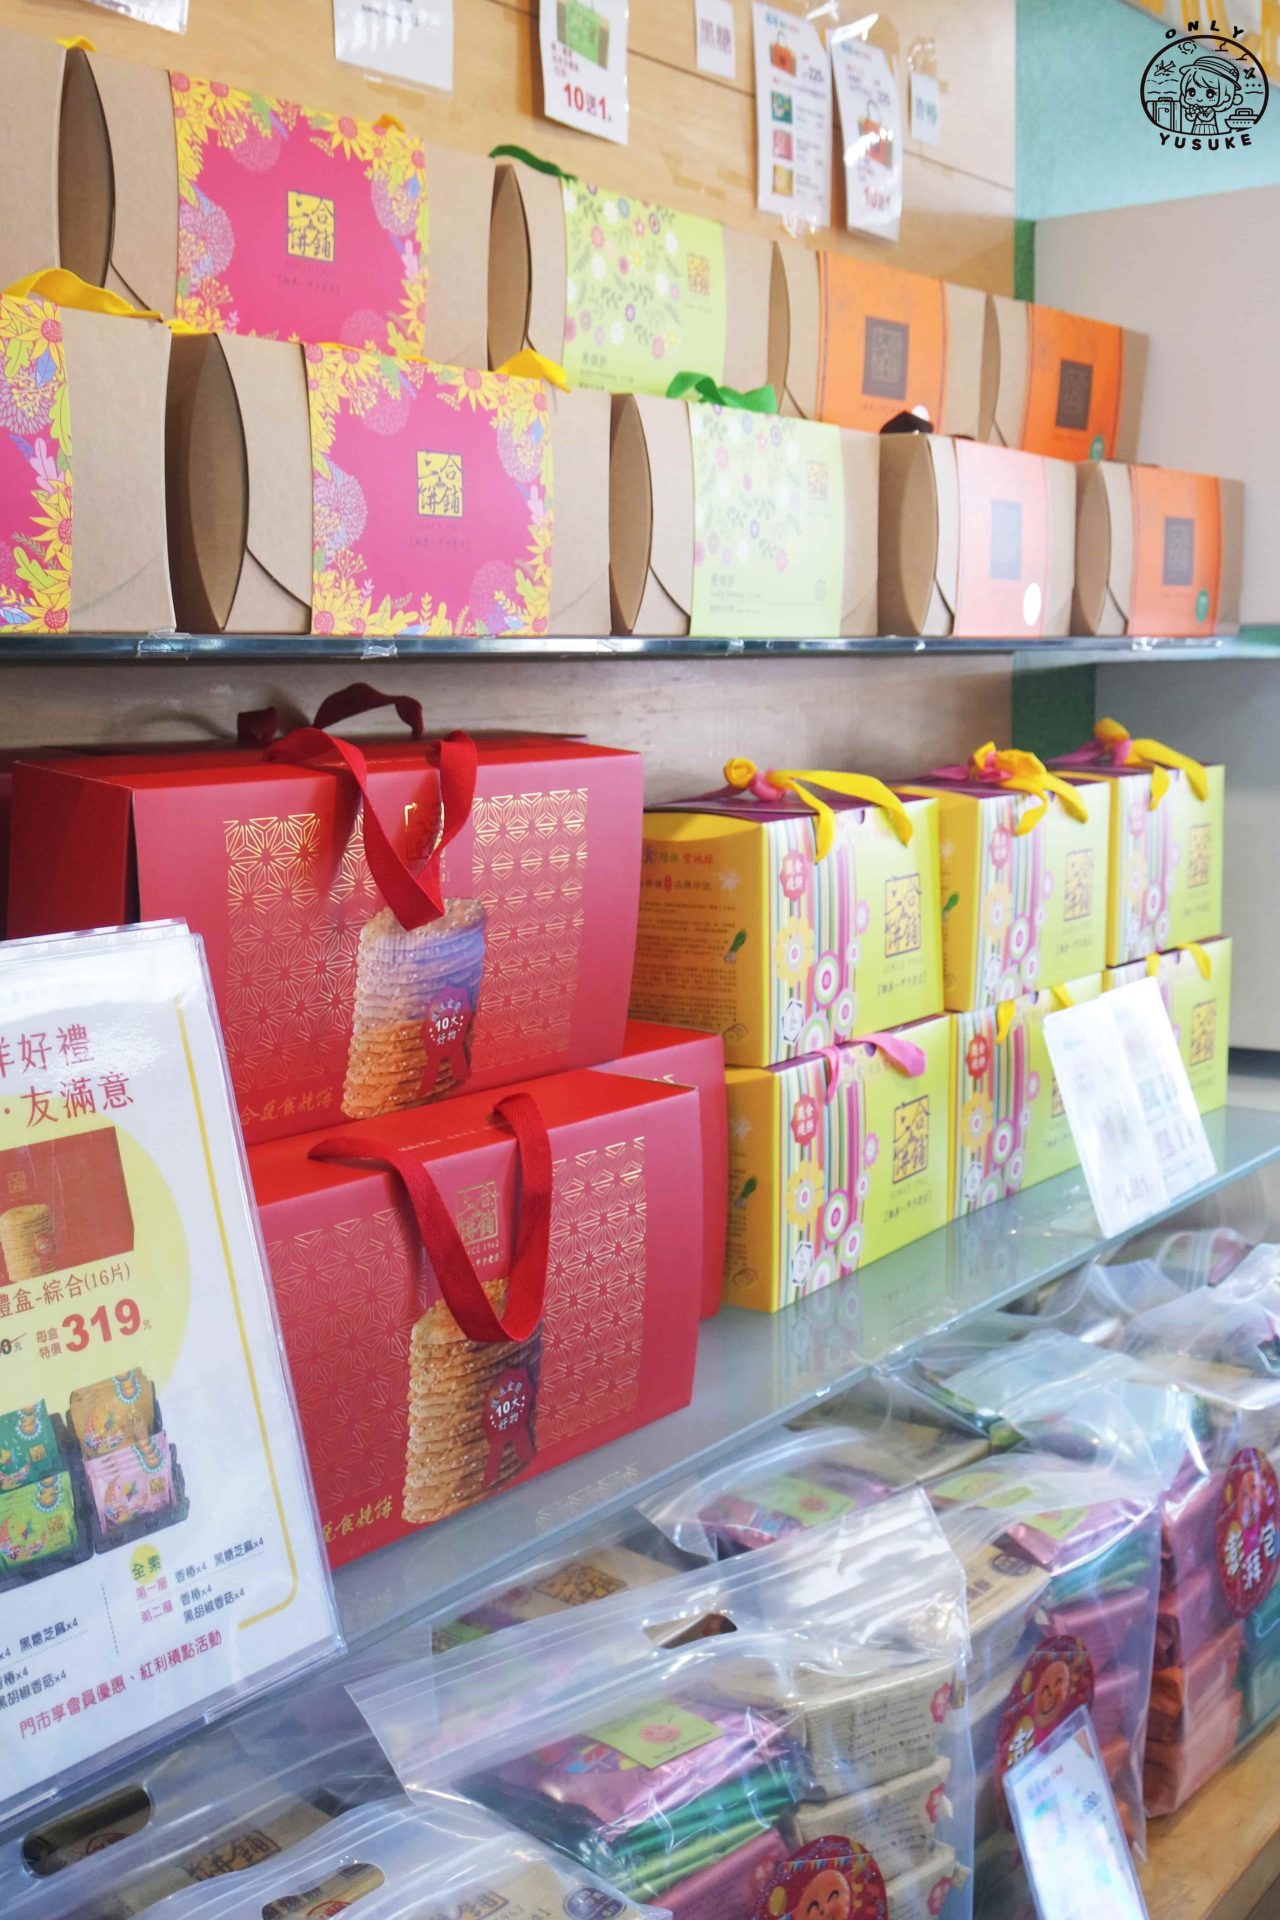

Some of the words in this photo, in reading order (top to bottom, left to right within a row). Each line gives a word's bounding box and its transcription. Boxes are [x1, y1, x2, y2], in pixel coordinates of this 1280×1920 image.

[131, 1554, 162, 1581] 全素
[135, 1575, 168, 1601] 第一層
[141, 1600, 173, 1625] 第二層
